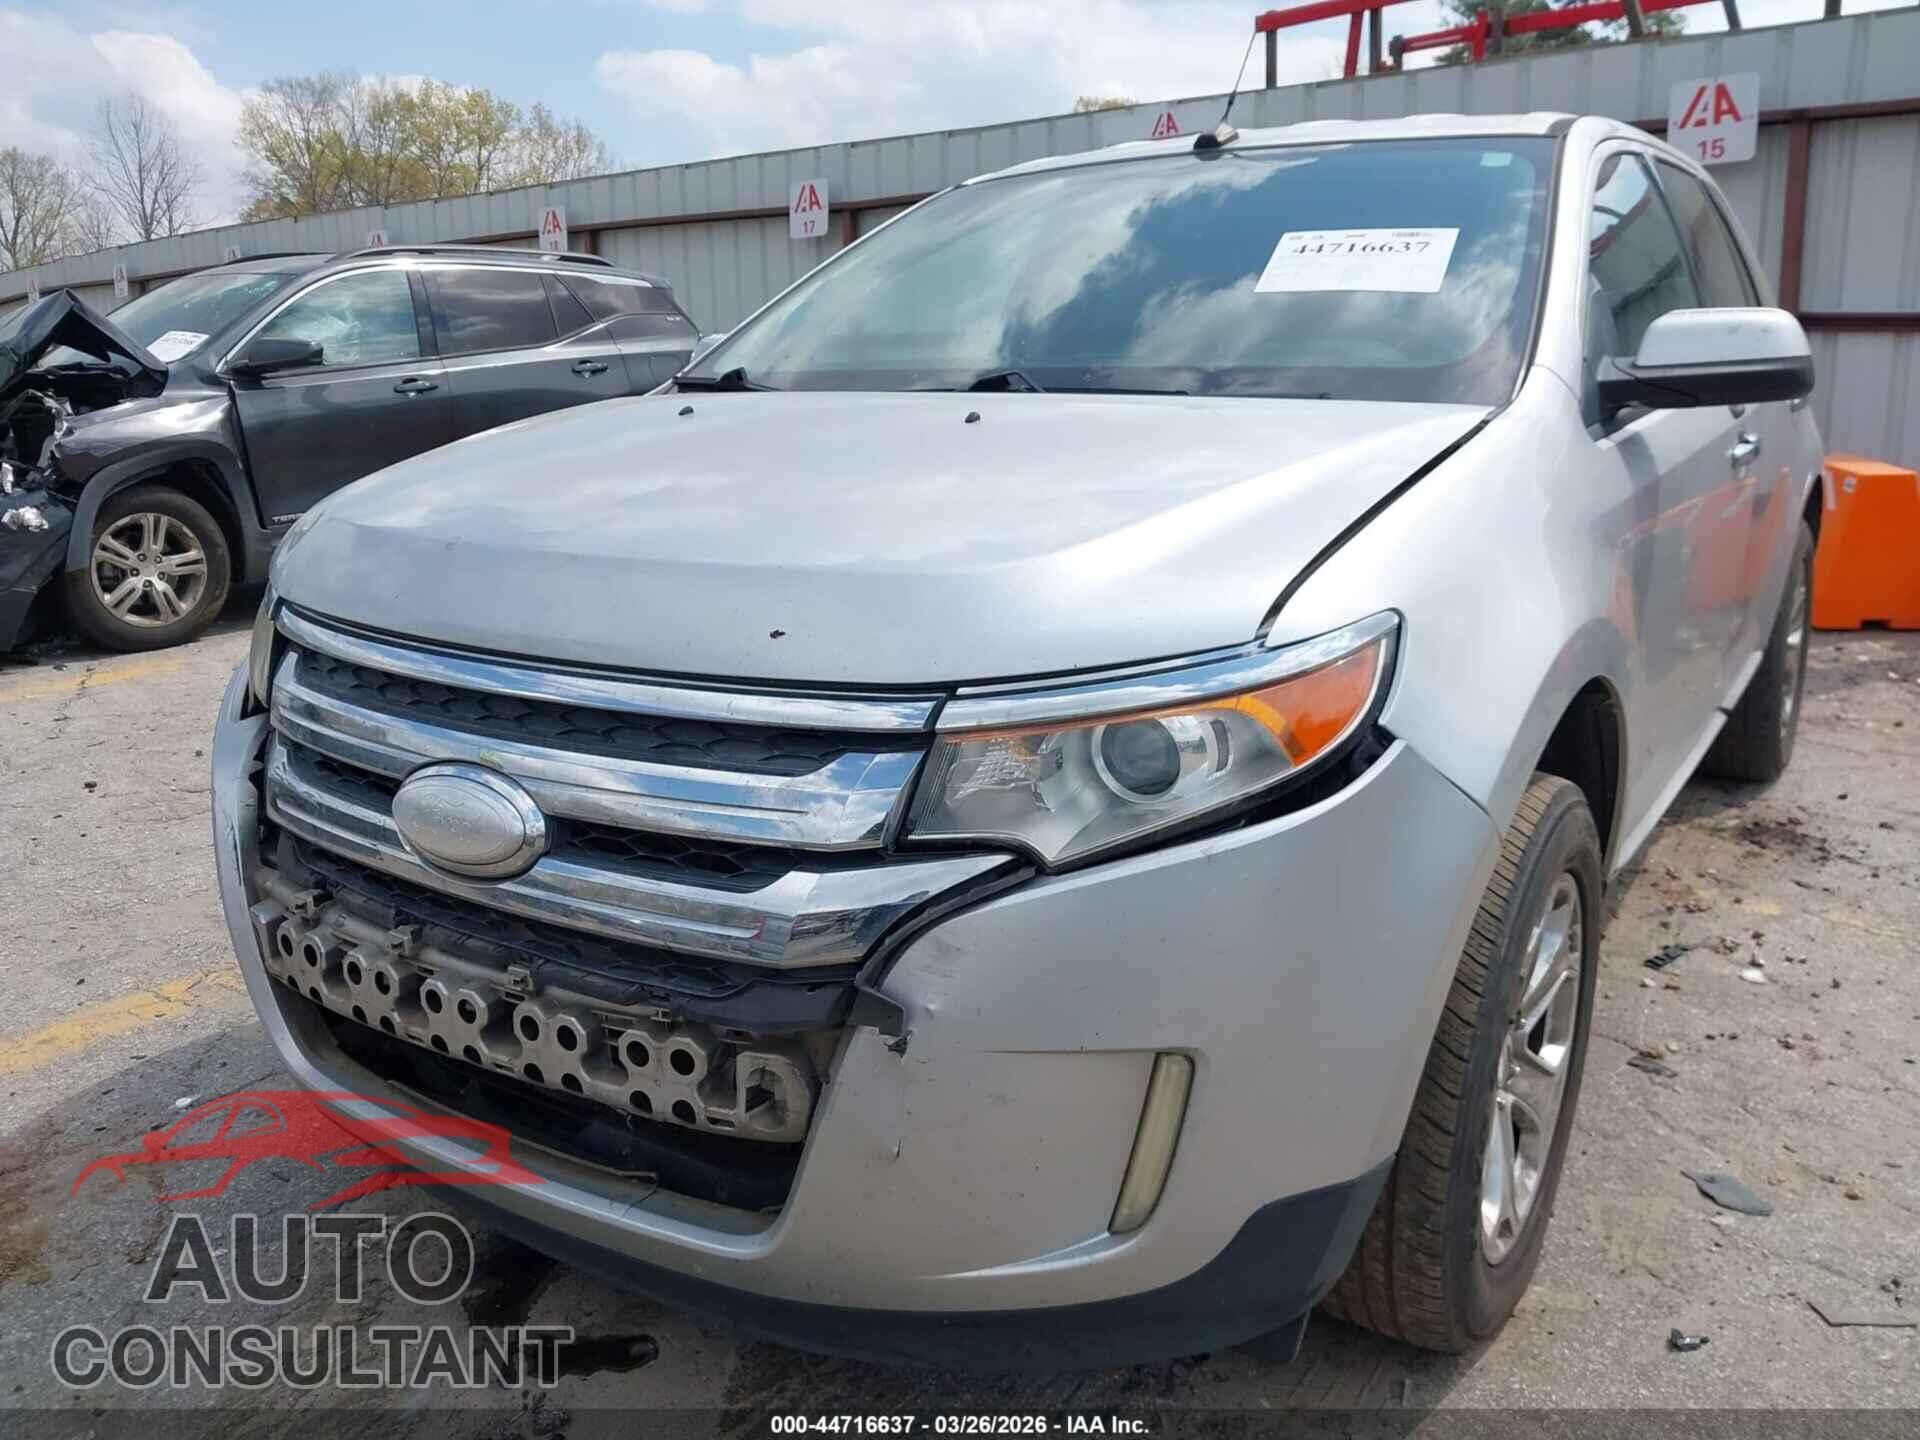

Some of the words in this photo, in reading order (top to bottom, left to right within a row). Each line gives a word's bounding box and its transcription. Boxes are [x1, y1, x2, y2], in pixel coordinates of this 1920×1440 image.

[1698, 138, 1725, 160] 15
[804, 220, 815, 233] 17
[1292, 241, 1431, 255] 44716637
